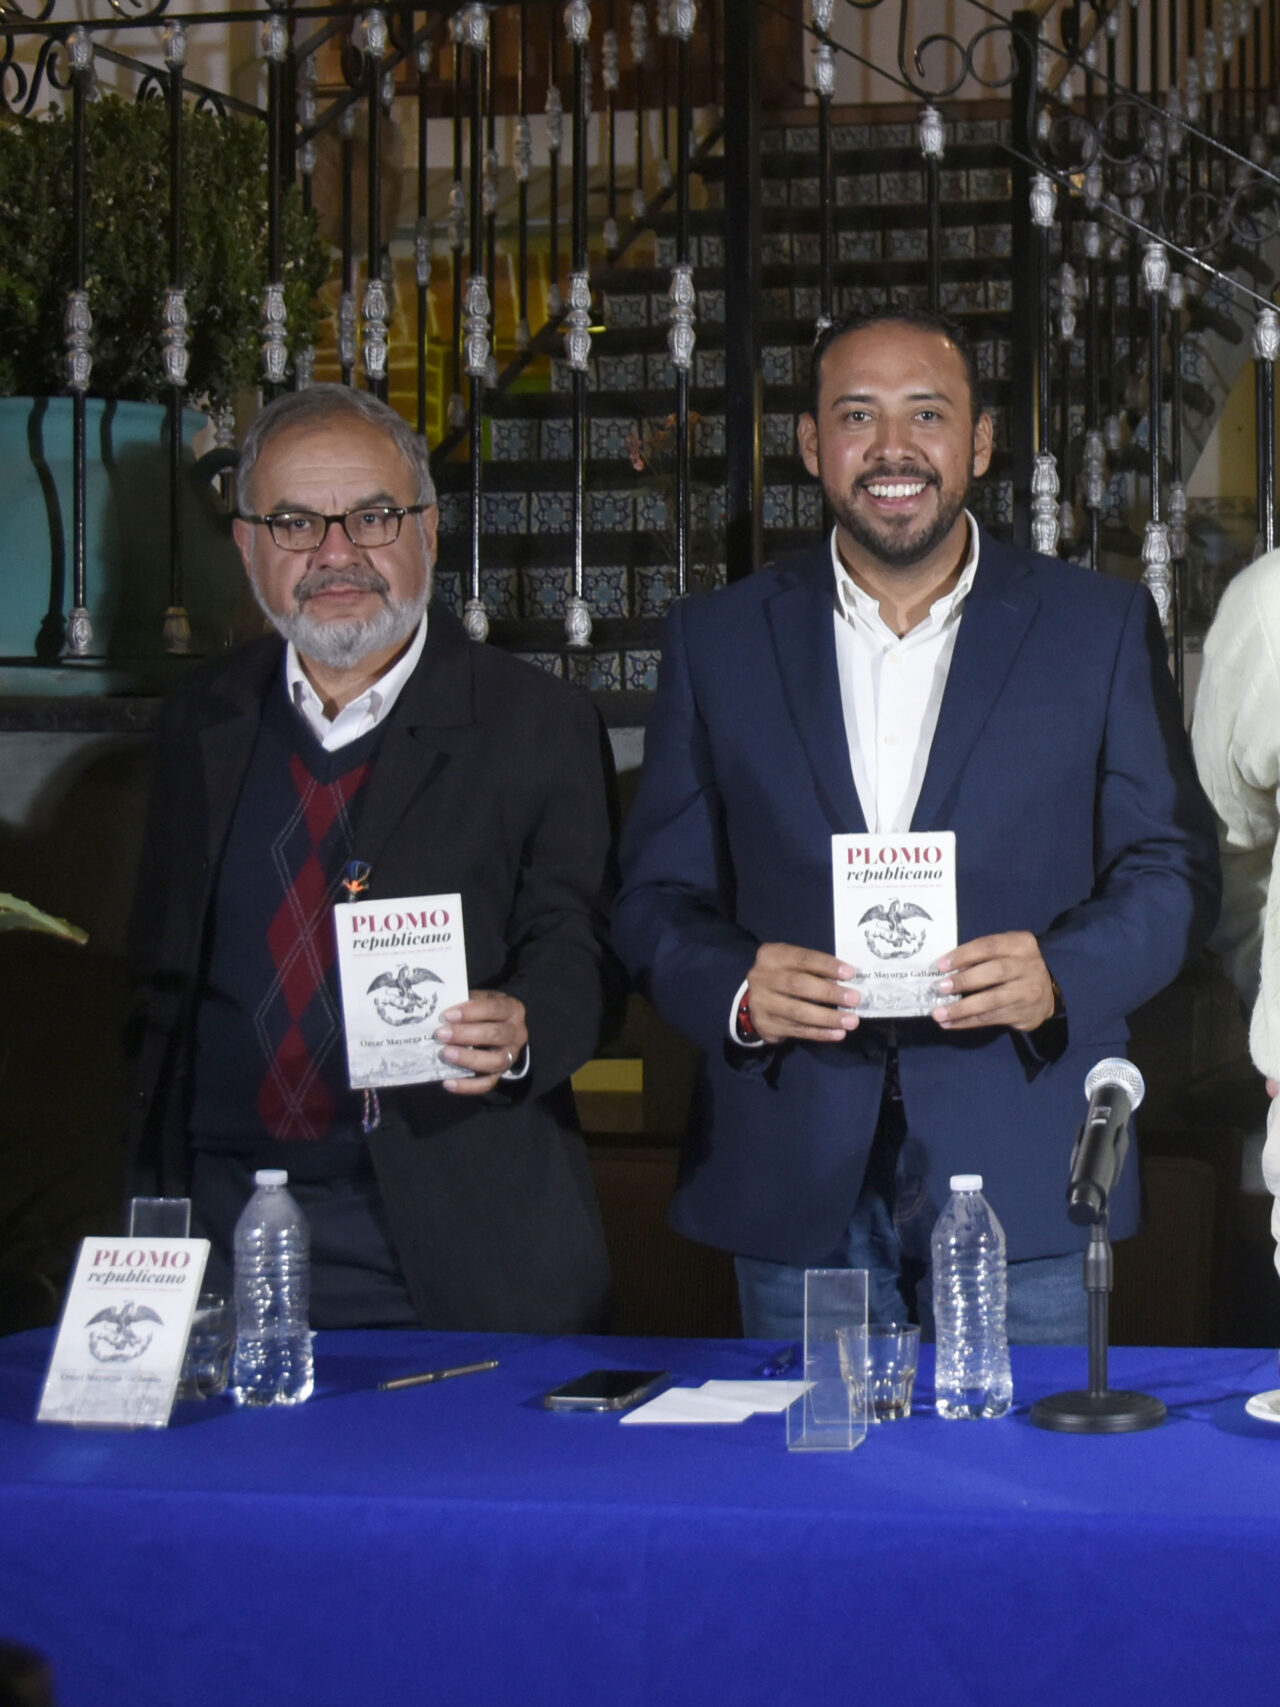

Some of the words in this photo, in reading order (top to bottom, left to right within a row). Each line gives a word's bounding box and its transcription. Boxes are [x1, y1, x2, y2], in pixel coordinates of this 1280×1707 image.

[847, 846, 943, 865] PLOMO
[846, 866, 943, 884] republicano
[351, 909, 450, 933] PLOMO
[352, 932, 452, 951] republicano
[855, 971, 871, 979] mar
[360, 1039, 384, 1048] Omar
[386, 1036, 422, 1046] Mayorga
[92, 1249, 191, 1269] PLOMO
[87, 1269, 187, 1285] republicano
